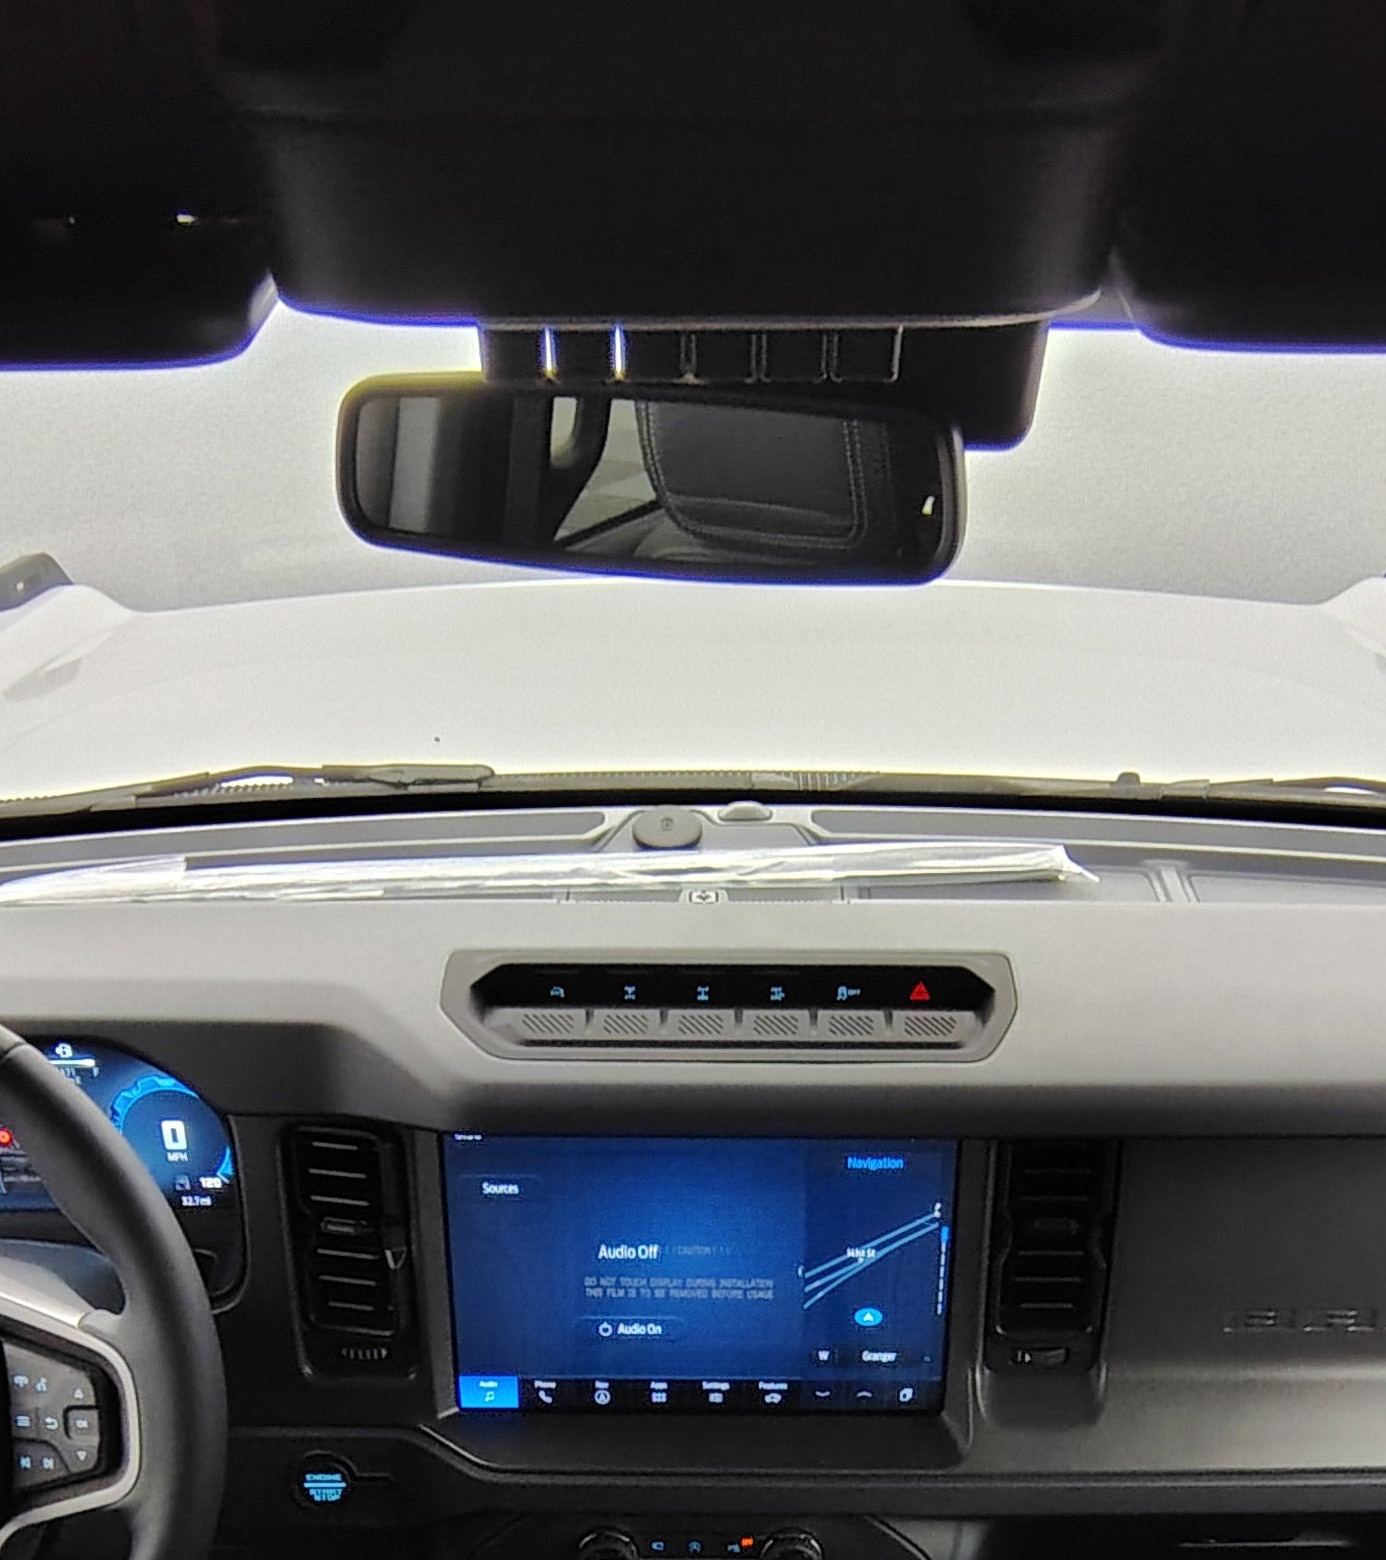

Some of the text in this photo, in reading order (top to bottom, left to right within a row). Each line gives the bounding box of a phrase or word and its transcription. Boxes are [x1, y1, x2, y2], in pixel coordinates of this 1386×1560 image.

[161, 1119, 188, 1150] 0
[166, 1152, 189, 1162] MPH
[847, 1156, 904, 1171] Navigation
[199, 1176, 222, 1189] 120
[481, 1181, 520, 1195] Sources
[598, 1243, 660, 1260] Audio Off
[617, 1322, 663, 1335] Audio On
[817, 1350, 830, 1361] W
